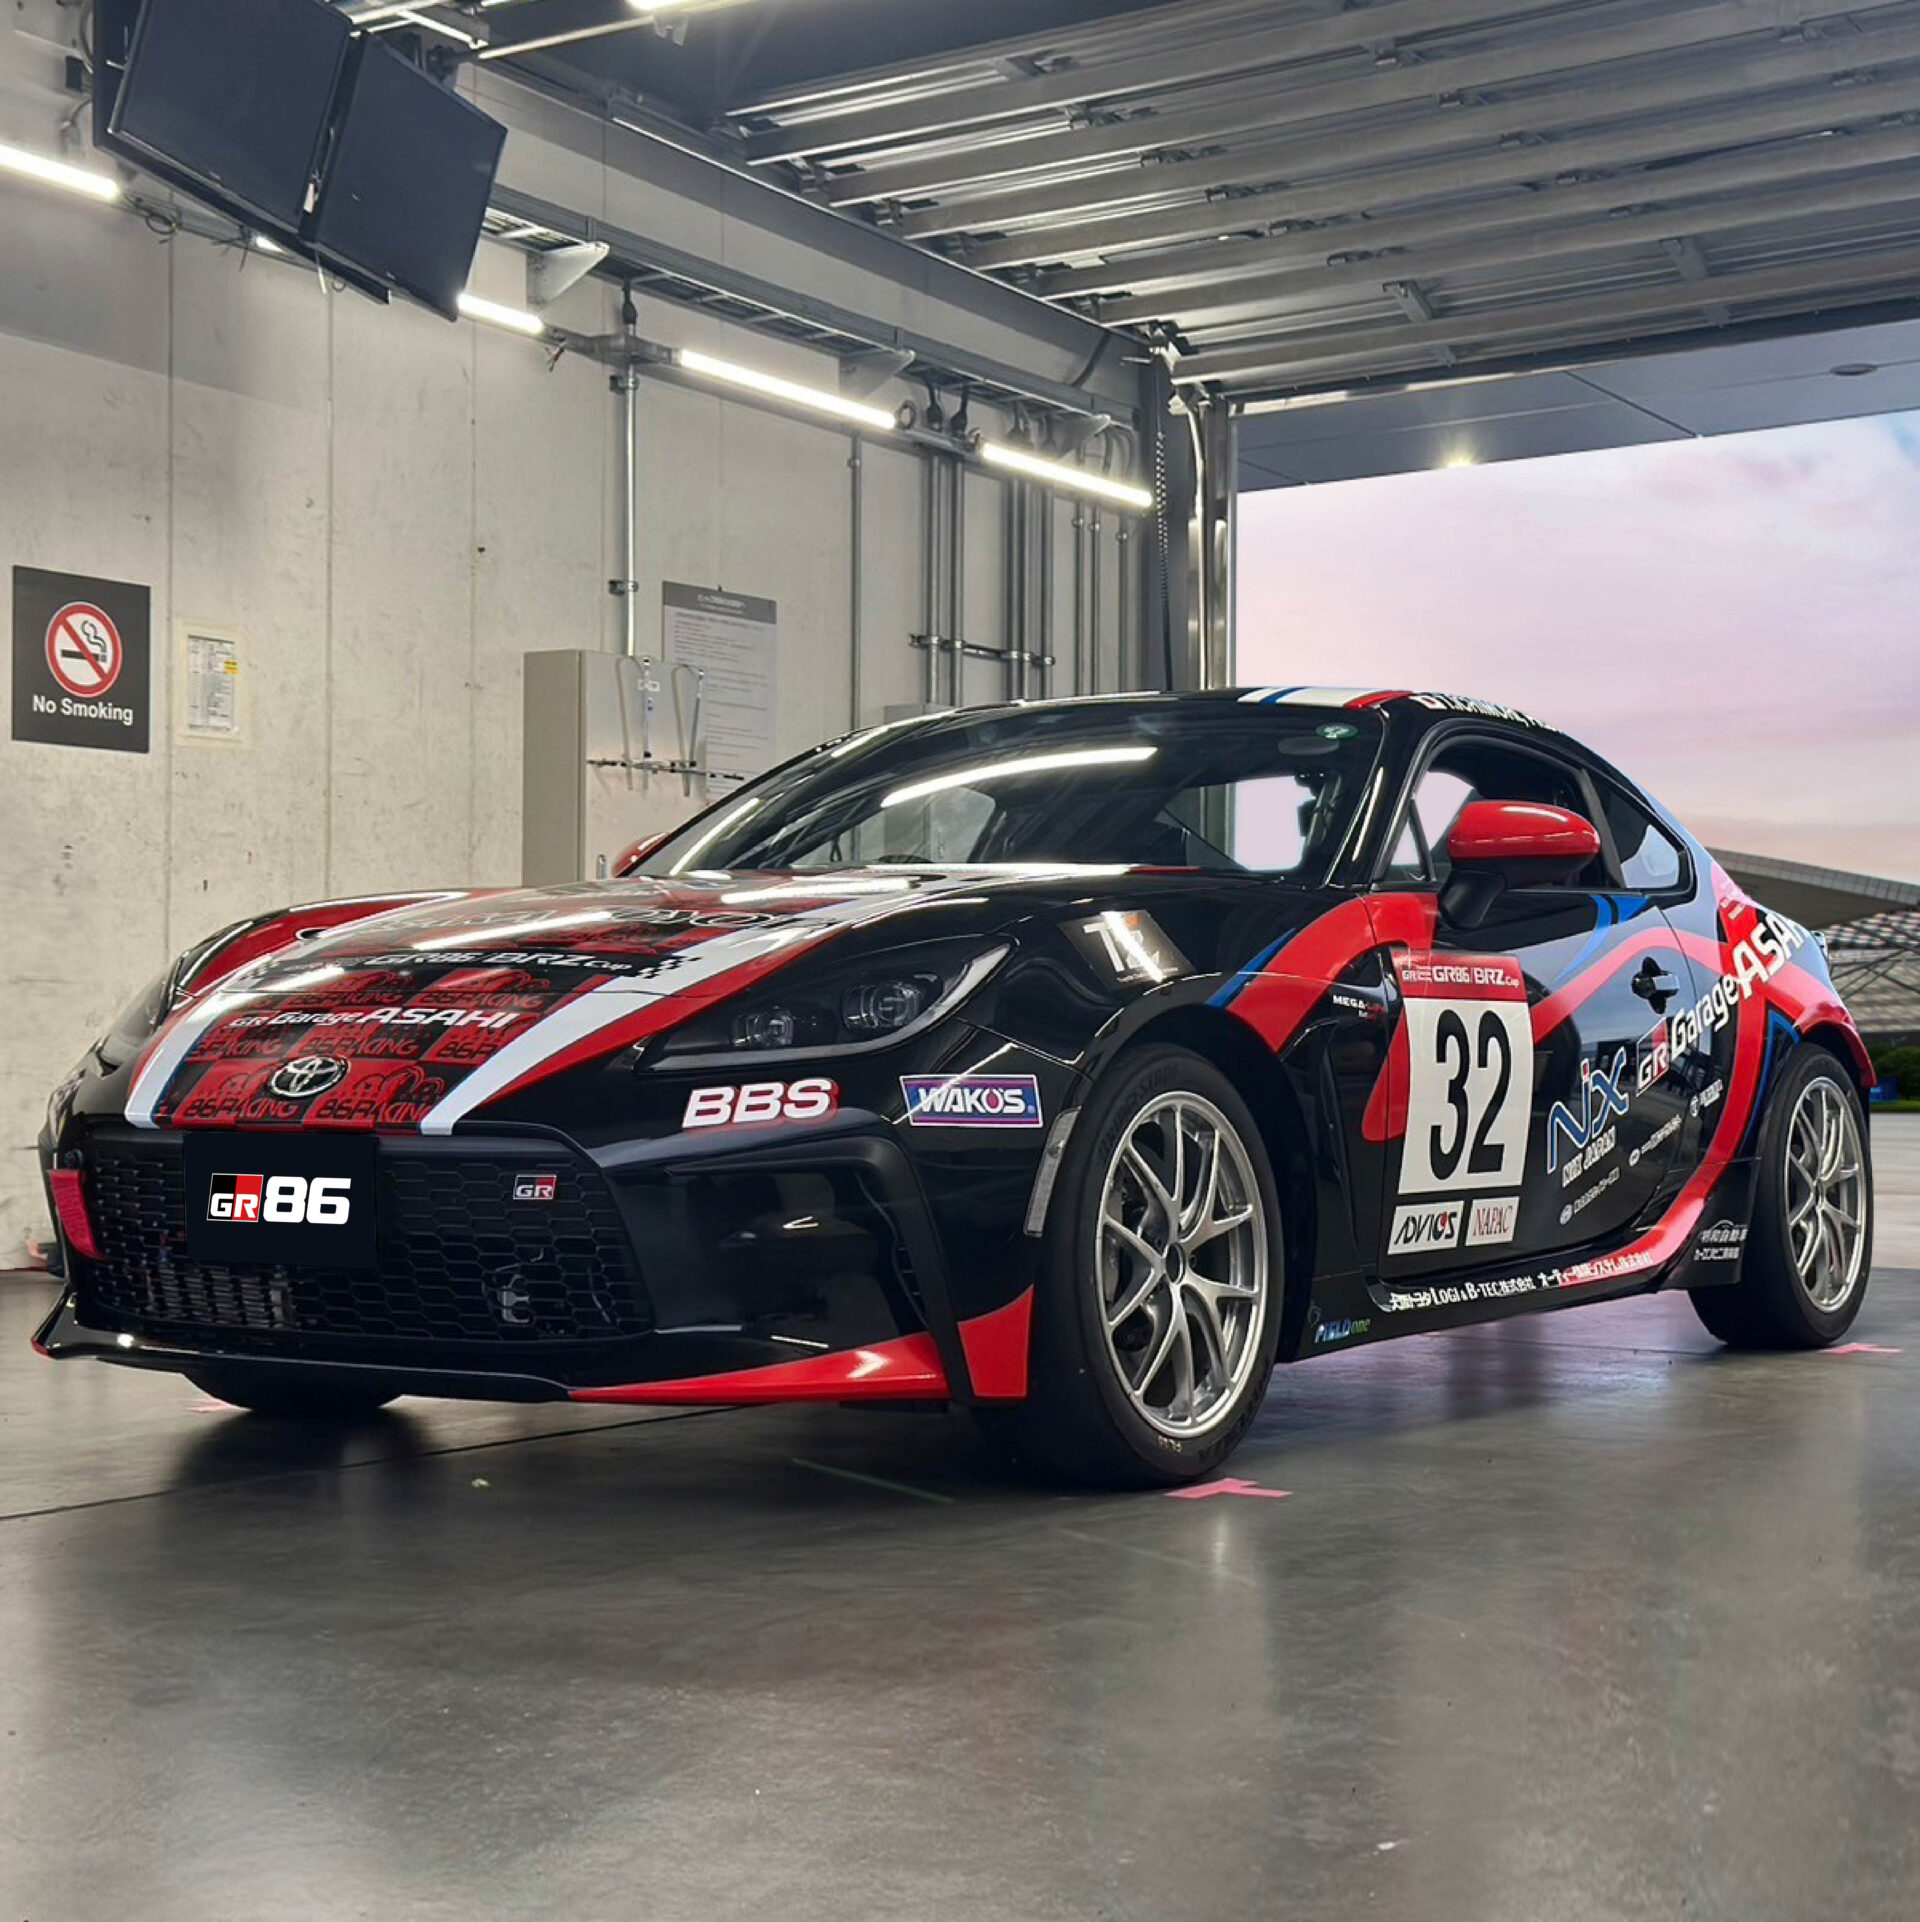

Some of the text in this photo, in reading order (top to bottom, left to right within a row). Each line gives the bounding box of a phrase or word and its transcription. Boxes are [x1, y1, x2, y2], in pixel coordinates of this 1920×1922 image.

[32, 694, 134, 726] No Smoking
[1473, 967, 1506, 986] BRZ
[228, 1006, 520, 1029] GR Garage ASAHI
[1670, 975, 1741, 1060] Garage
[682, 1078, 840, 1129] BBS
[1430, 1008, 1512, 1181] 32
[1394, 1210, 1457, 1245] ADVICS
[1473, 1205, 1513, 1236] NAPAC
